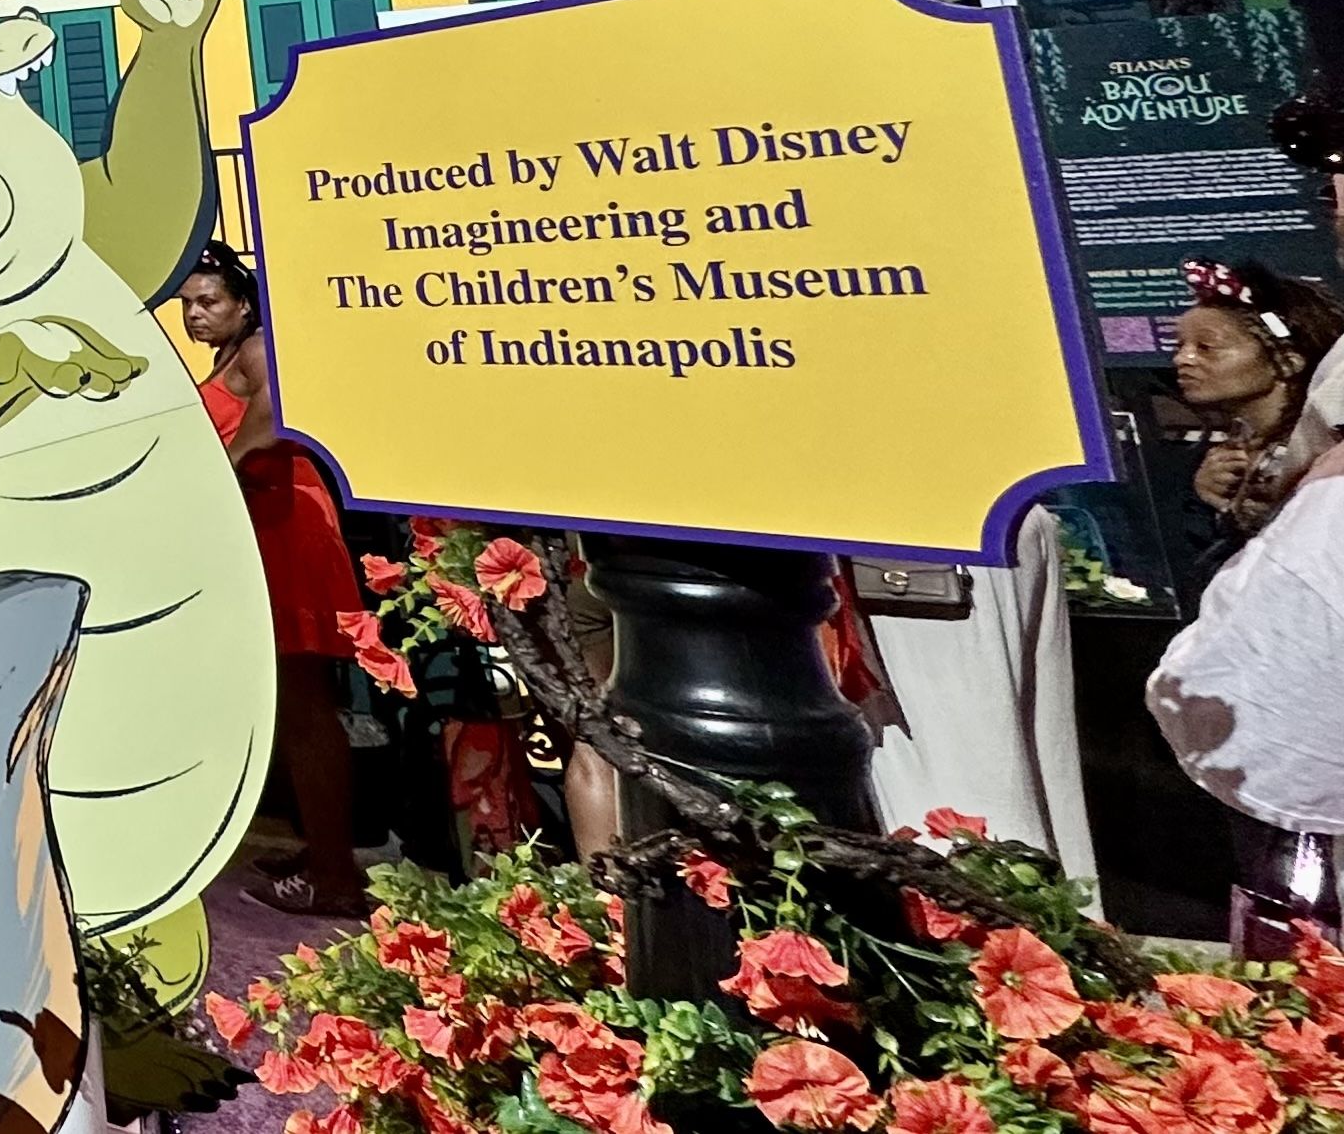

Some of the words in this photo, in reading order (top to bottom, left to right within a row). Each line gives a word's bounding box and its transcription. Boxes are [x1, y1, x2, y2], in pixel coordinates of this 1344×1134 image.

[1101, 72, 1212, 100] BAYOU
[1109, 57, 1192, 74] TIANA'S
[1081, 95, 1249, 130] ADVENTURE
[306, 151, 494, 202] Produced
[506, 148, 562, 191] by
[577, 131, 699, 179] Walt
[711, 118, 913, 167] Disney
[382, 201, 690, 255] Imagineering
[705, 188, 812, 234] and
[328, 274, 404, 311] The
[414, 263, 656, 307] Children's
[672, 258, 928, 302] Museum
[425, 330, 467, 367] of
[478, 326, 796, 378] Indianapolis
